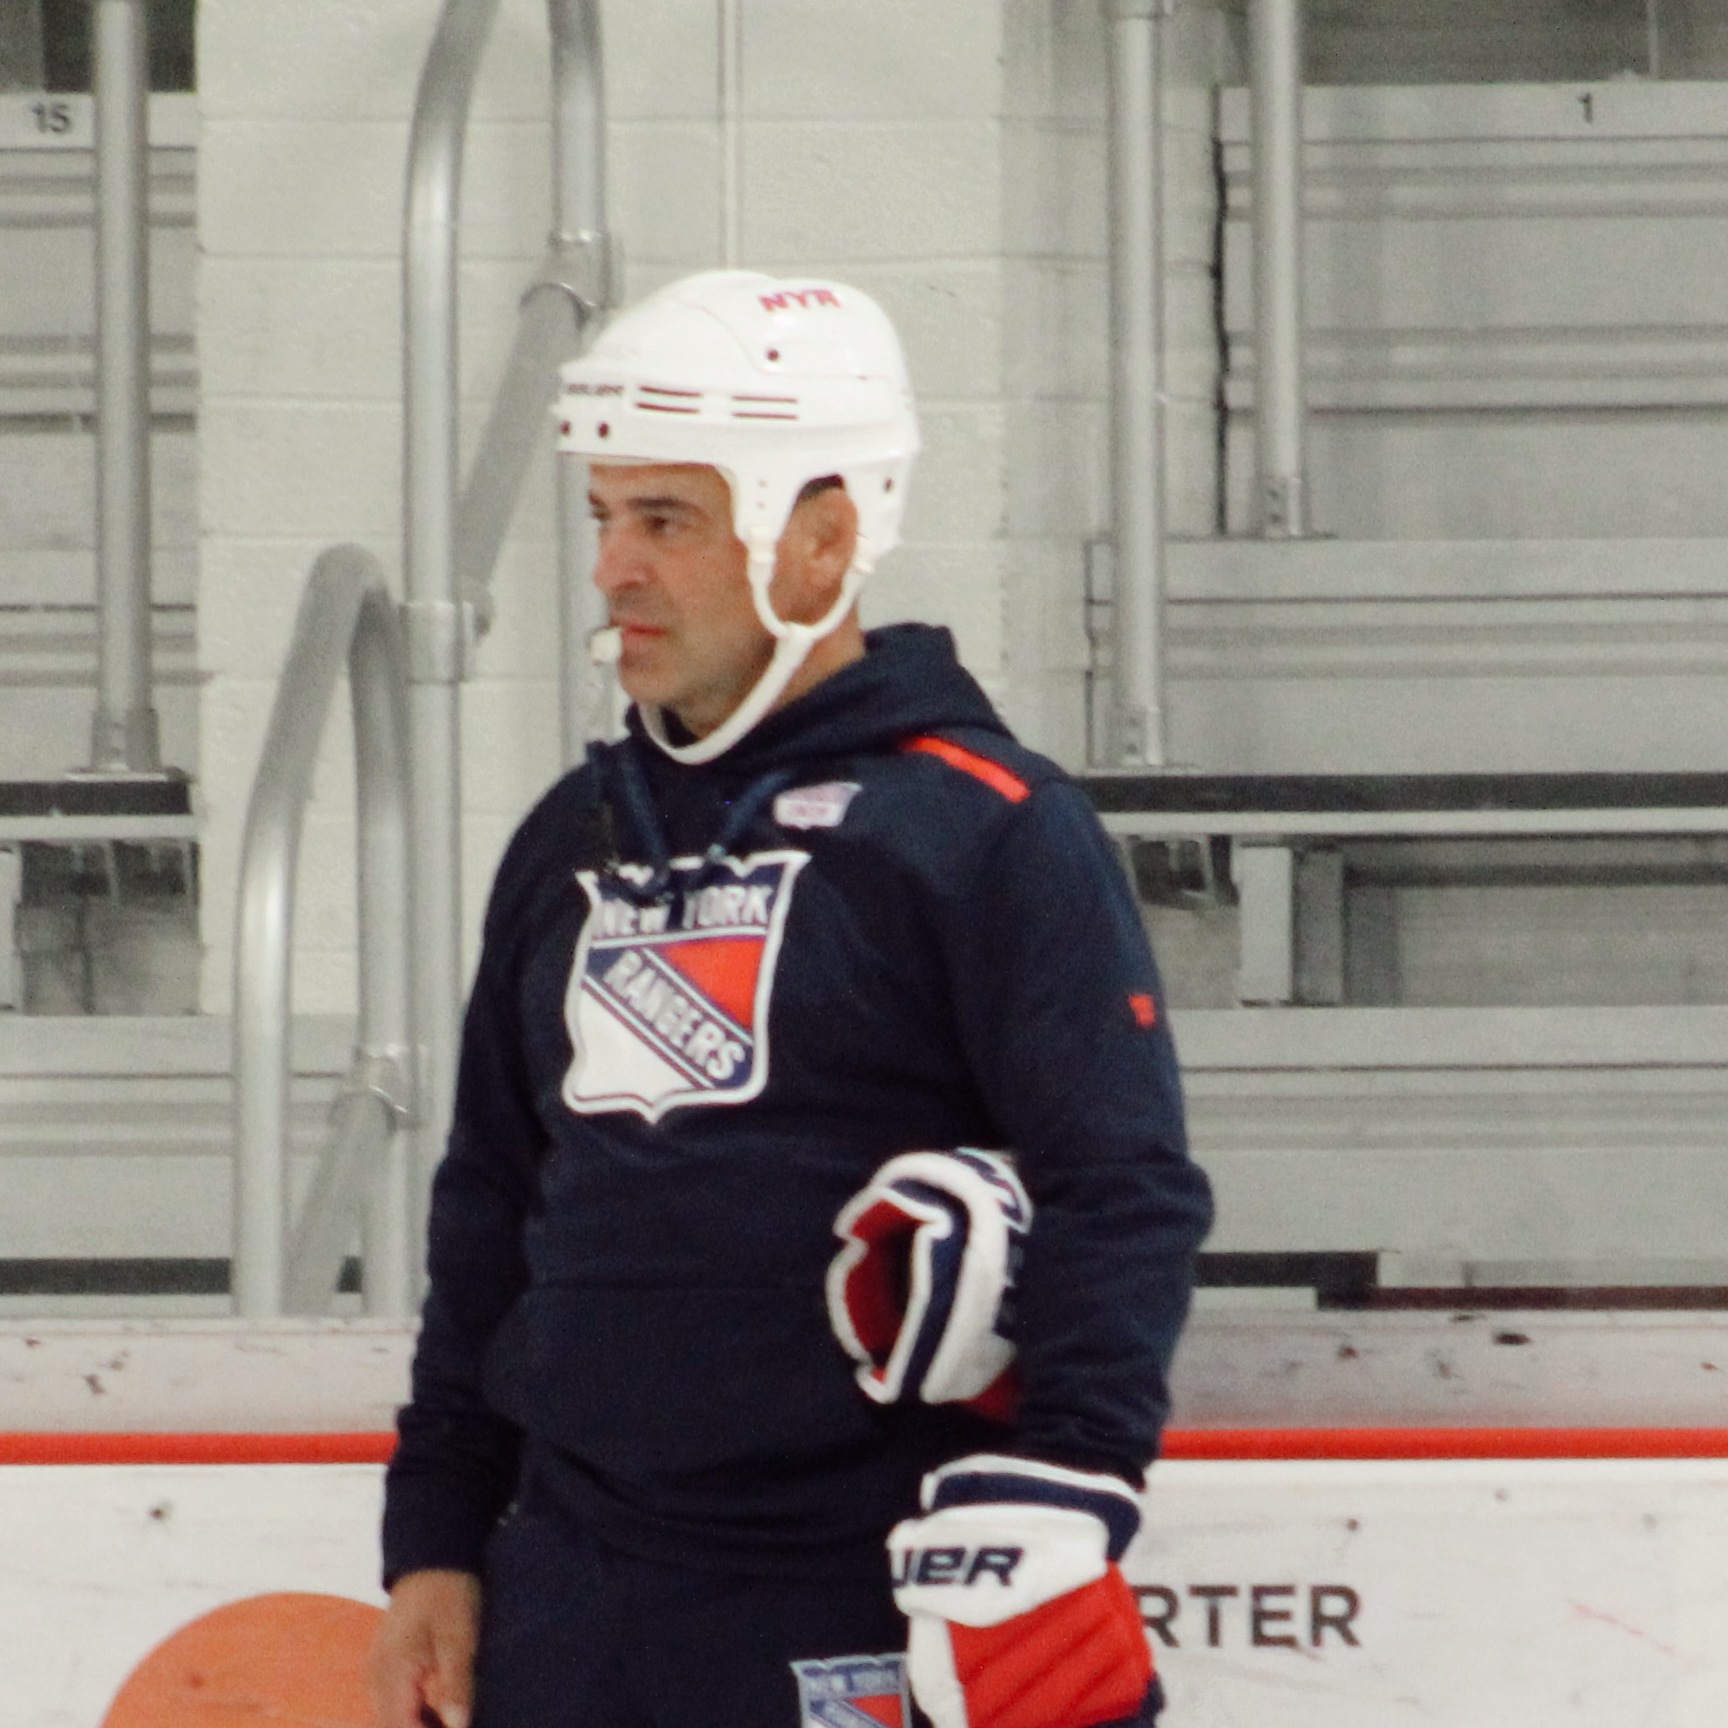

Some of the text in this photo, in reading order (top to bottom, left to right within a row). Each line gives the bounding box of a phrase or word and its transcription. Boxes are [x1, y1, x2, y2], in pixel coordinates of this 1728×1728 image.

[32, 103, 71, 134] 15
[1577, 92, 1594, 123] 1
[758, 288, 841, 312] NYR
[604, 950, 746, 1081] RANGERS
[1133, 1584, 1360, 1648] RTER
